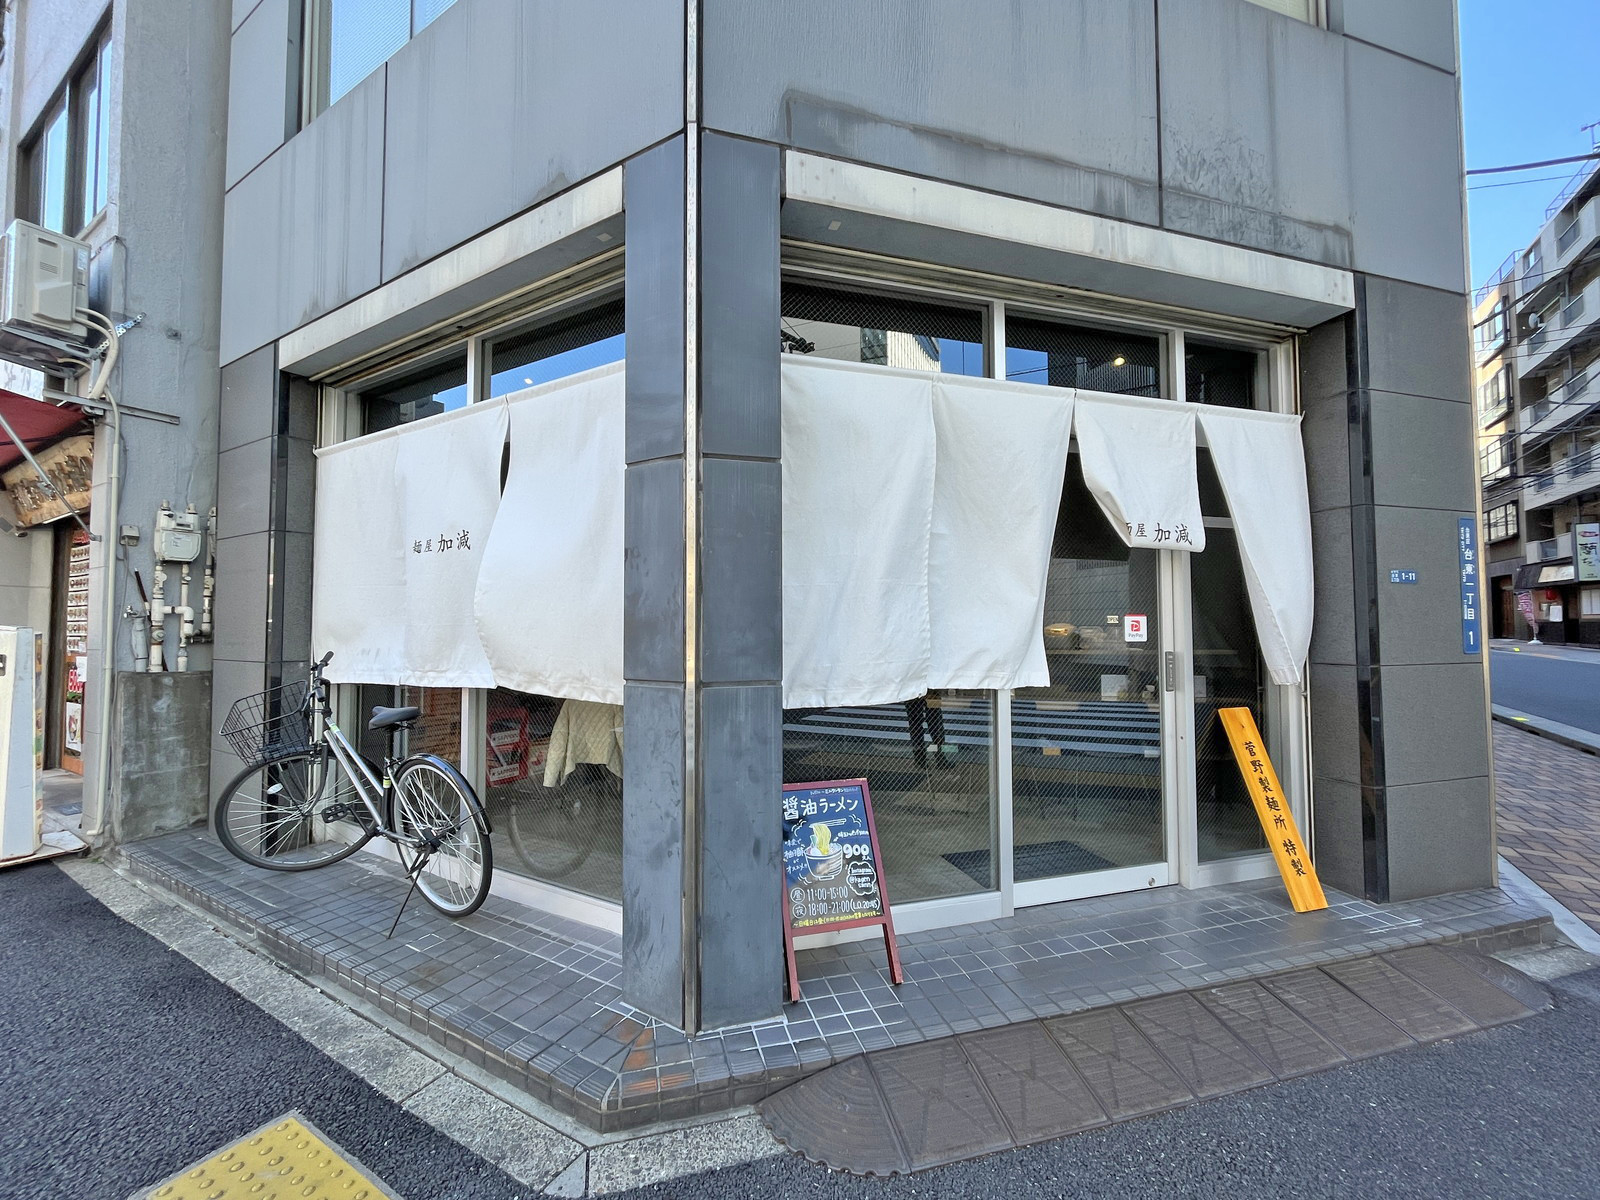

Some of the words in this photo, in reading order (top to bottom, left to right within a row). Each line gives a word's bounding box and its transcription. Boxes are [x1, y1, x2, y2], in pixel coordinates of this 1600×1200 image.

[1402, 572, 1416, 581] 1-11
[782, 796, 858, 820] 醤油ラーメン
[842, 843, 870, 858] 900
[807, 886, 848, 901] 11:00-15:00
[808, 901, 850, 916] 18:00-21:00
